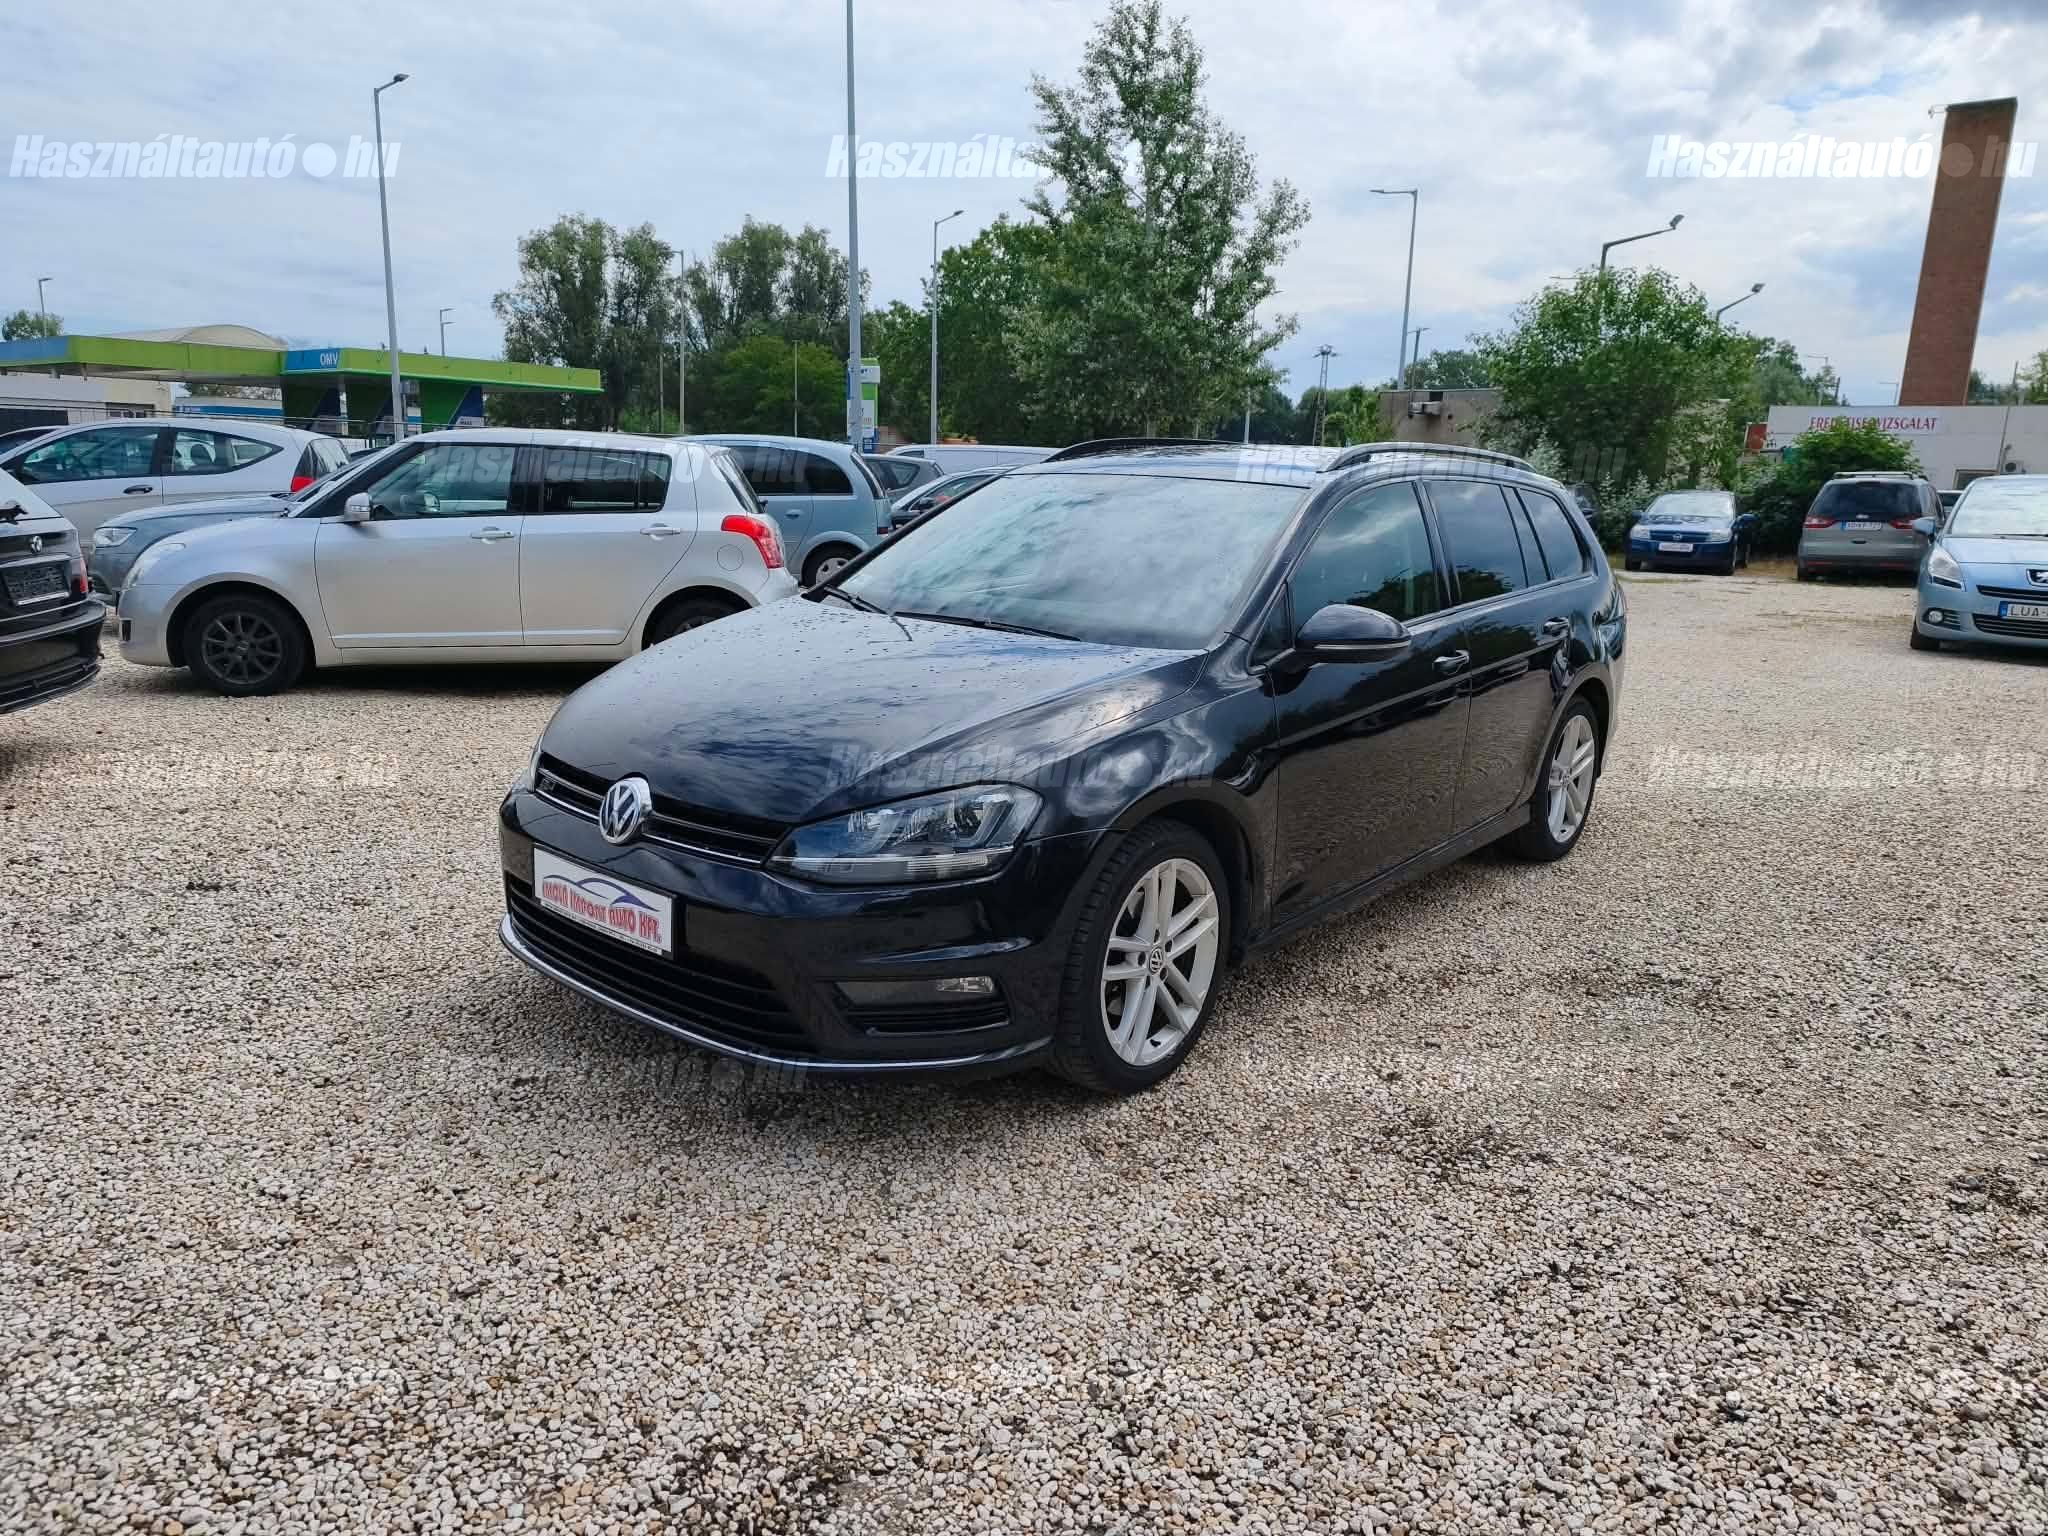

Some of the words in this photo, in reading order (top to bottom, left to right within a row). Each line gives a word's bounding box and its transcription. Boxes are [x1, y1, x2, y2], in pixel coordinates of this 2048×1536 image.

[320, 352, 338, 366] OMV
[2010, 605, 2048, 617] LUA-
[570, 888, 608, 923] IMPORT
